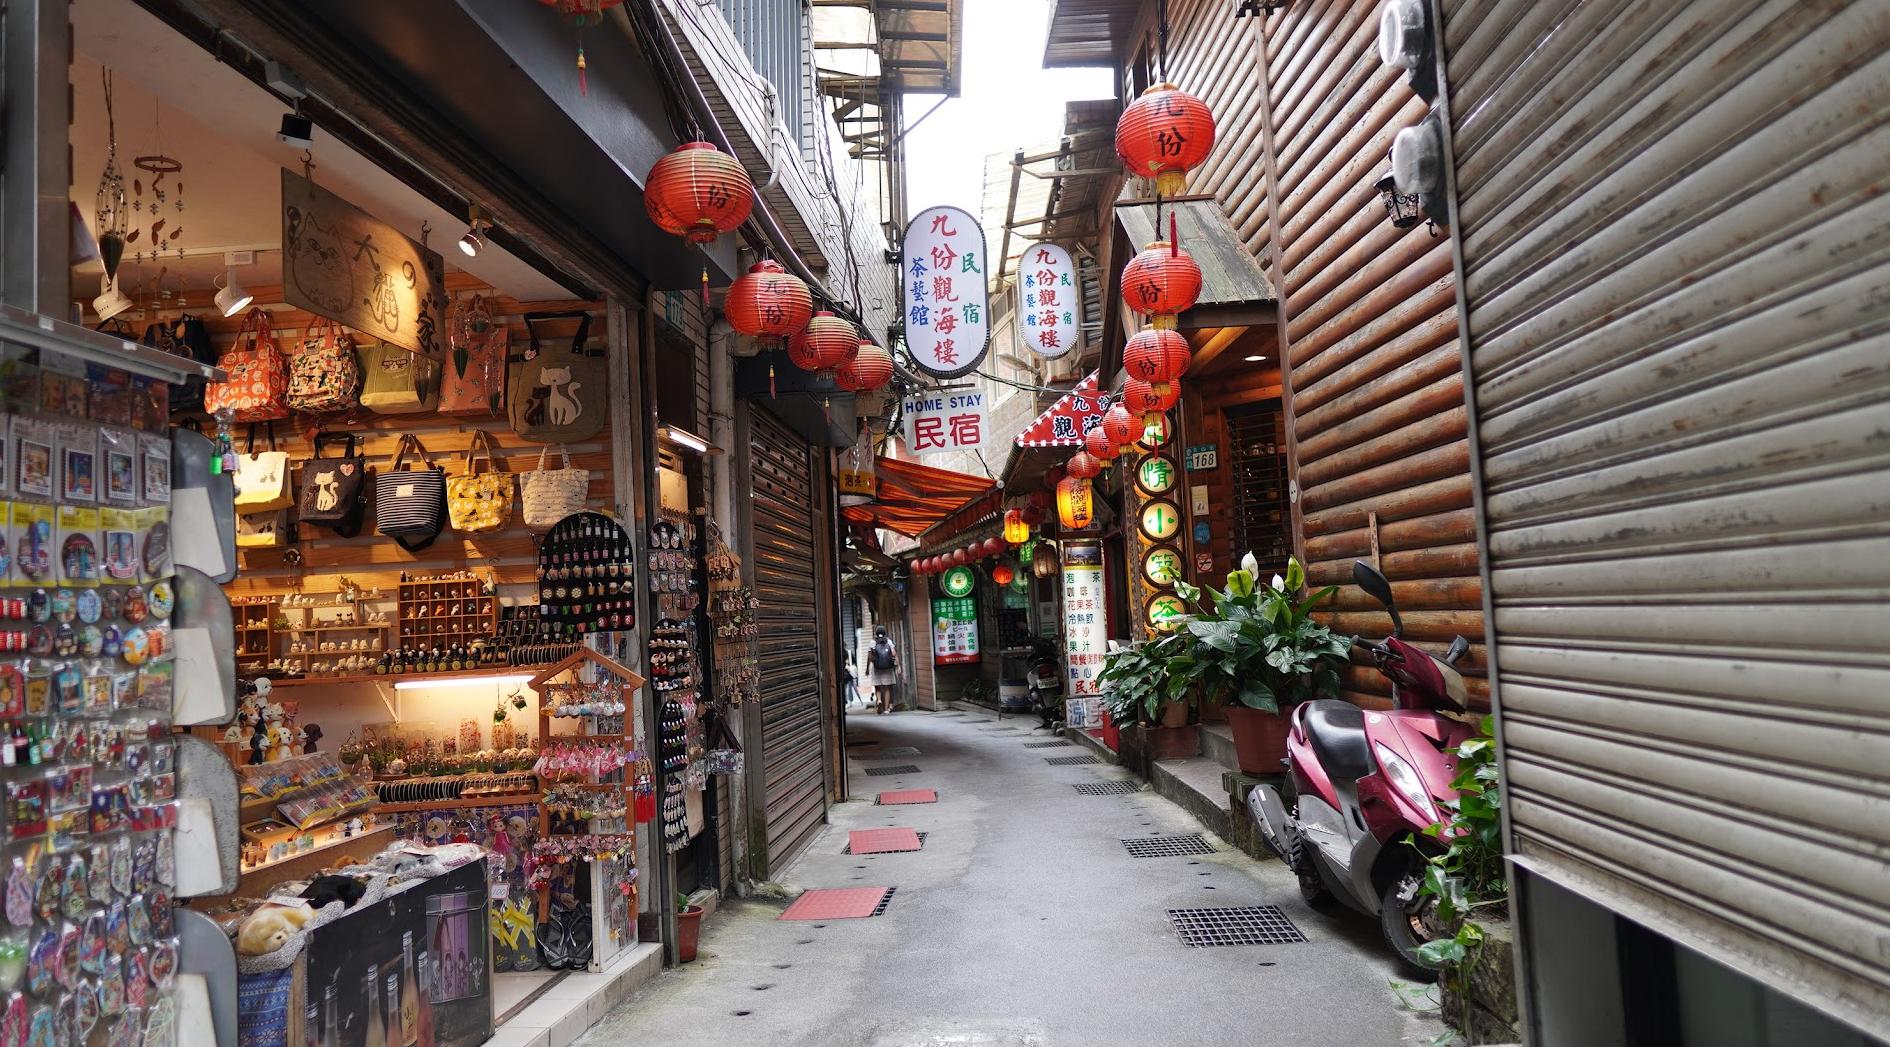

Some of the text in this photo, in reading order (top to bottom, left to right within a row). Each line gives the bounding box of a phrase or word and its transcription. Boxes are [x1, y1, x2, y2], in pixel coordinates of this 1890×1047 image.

[1153, 94, 1187, 157] 九份
[909, 257, 930, 327] 茶藝館
[930, 214, 959, 366] 九份觀海樓
[962, 252, 981, 325] 民宿
[1061, 272, 1073, 326] 民宿
[906, 393, 982, 414] HOME STAY
[913, 412, 982, 452] 民宿
[1195, 453, 1214, 467] 168
[1075, 680, 1100, 694] 民宿
